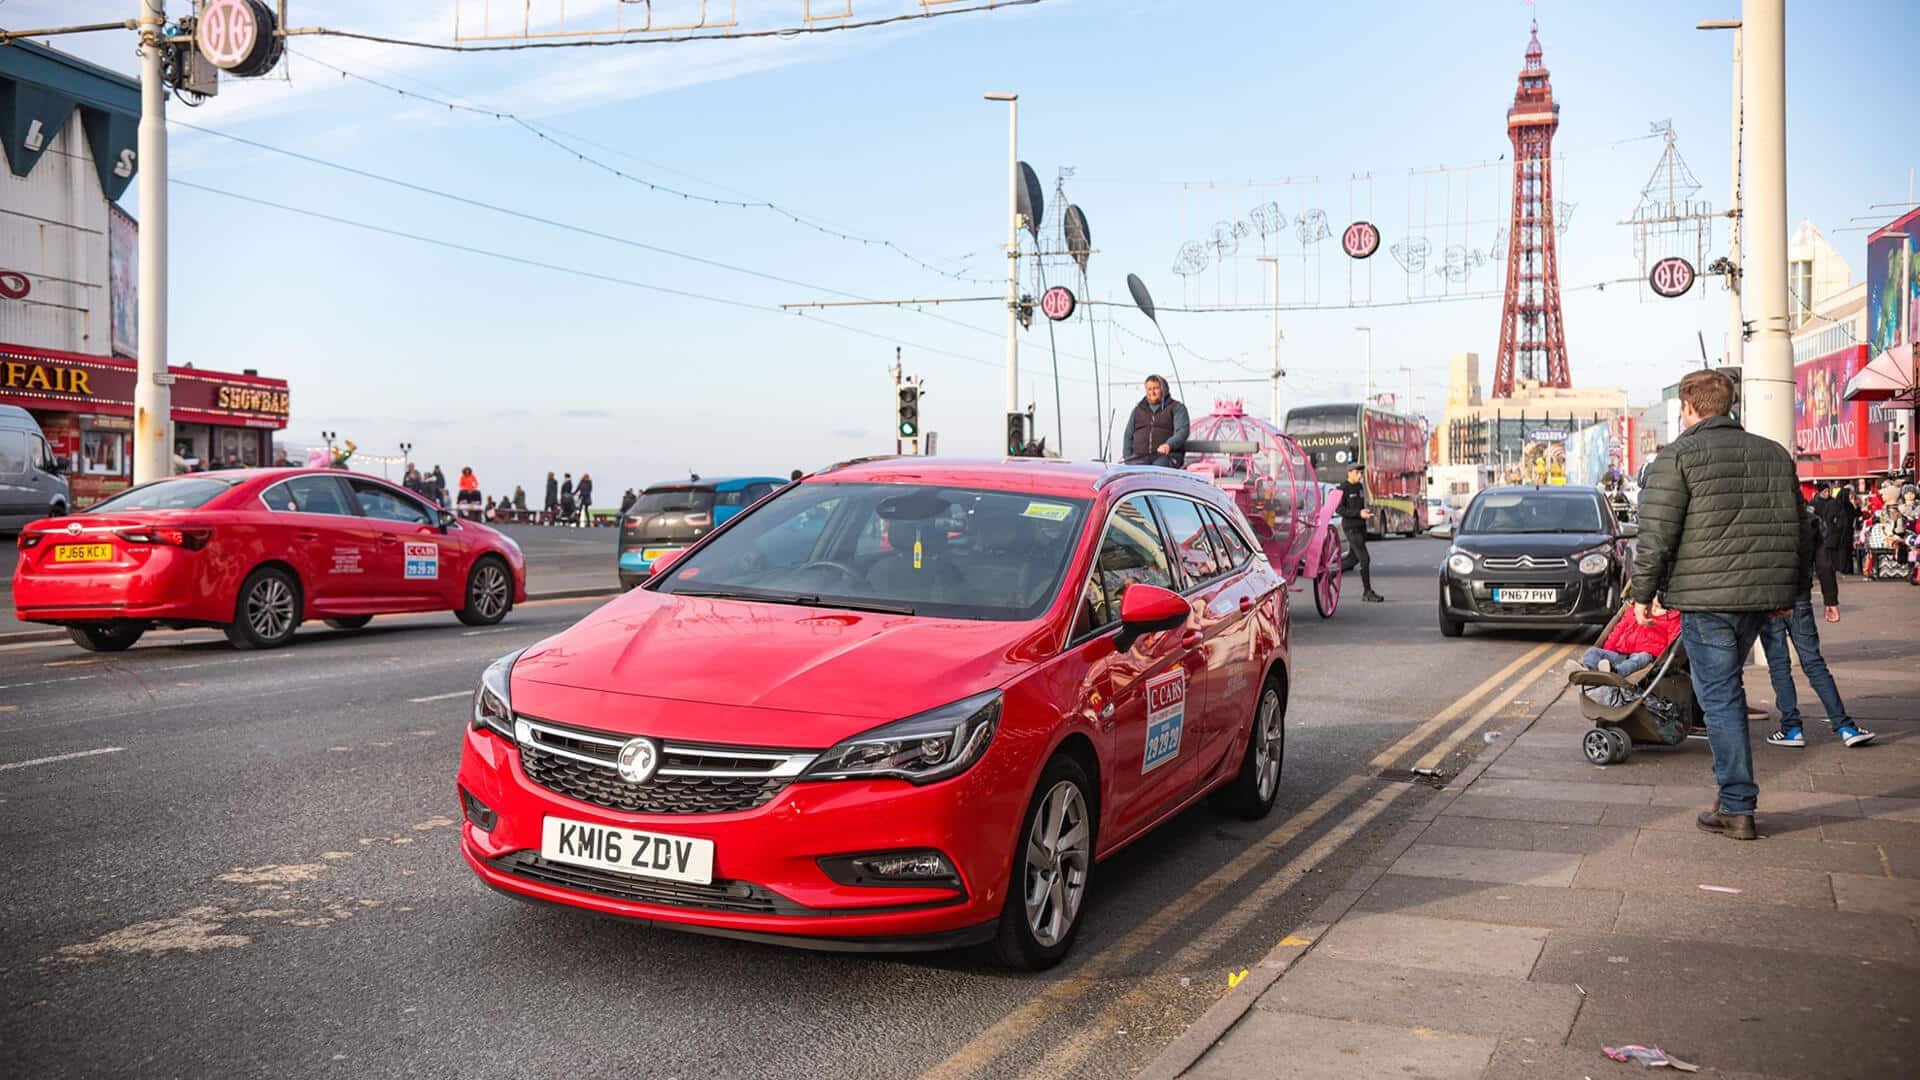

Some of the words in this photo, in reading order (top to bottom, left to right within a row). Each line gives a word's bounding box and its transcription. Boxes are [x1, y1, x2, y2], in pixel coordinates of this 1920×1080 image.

[0, 361, 94, 394] FAIR
[1296, 435, 1344, 447] ALLADIUM
[1813, 421, 1855, 451] DANCING
[59, 546, 85, 560] PJ66
[86, 546, 107, 558] KCX
[1501, 591, 1529, 601] PN67
[1532, 591, 1553, 601] PHY
[1151, 689, 1159, 709] C
[559, 822, 623, 864] KM16
[631, 835, 693, 874] ZDV
